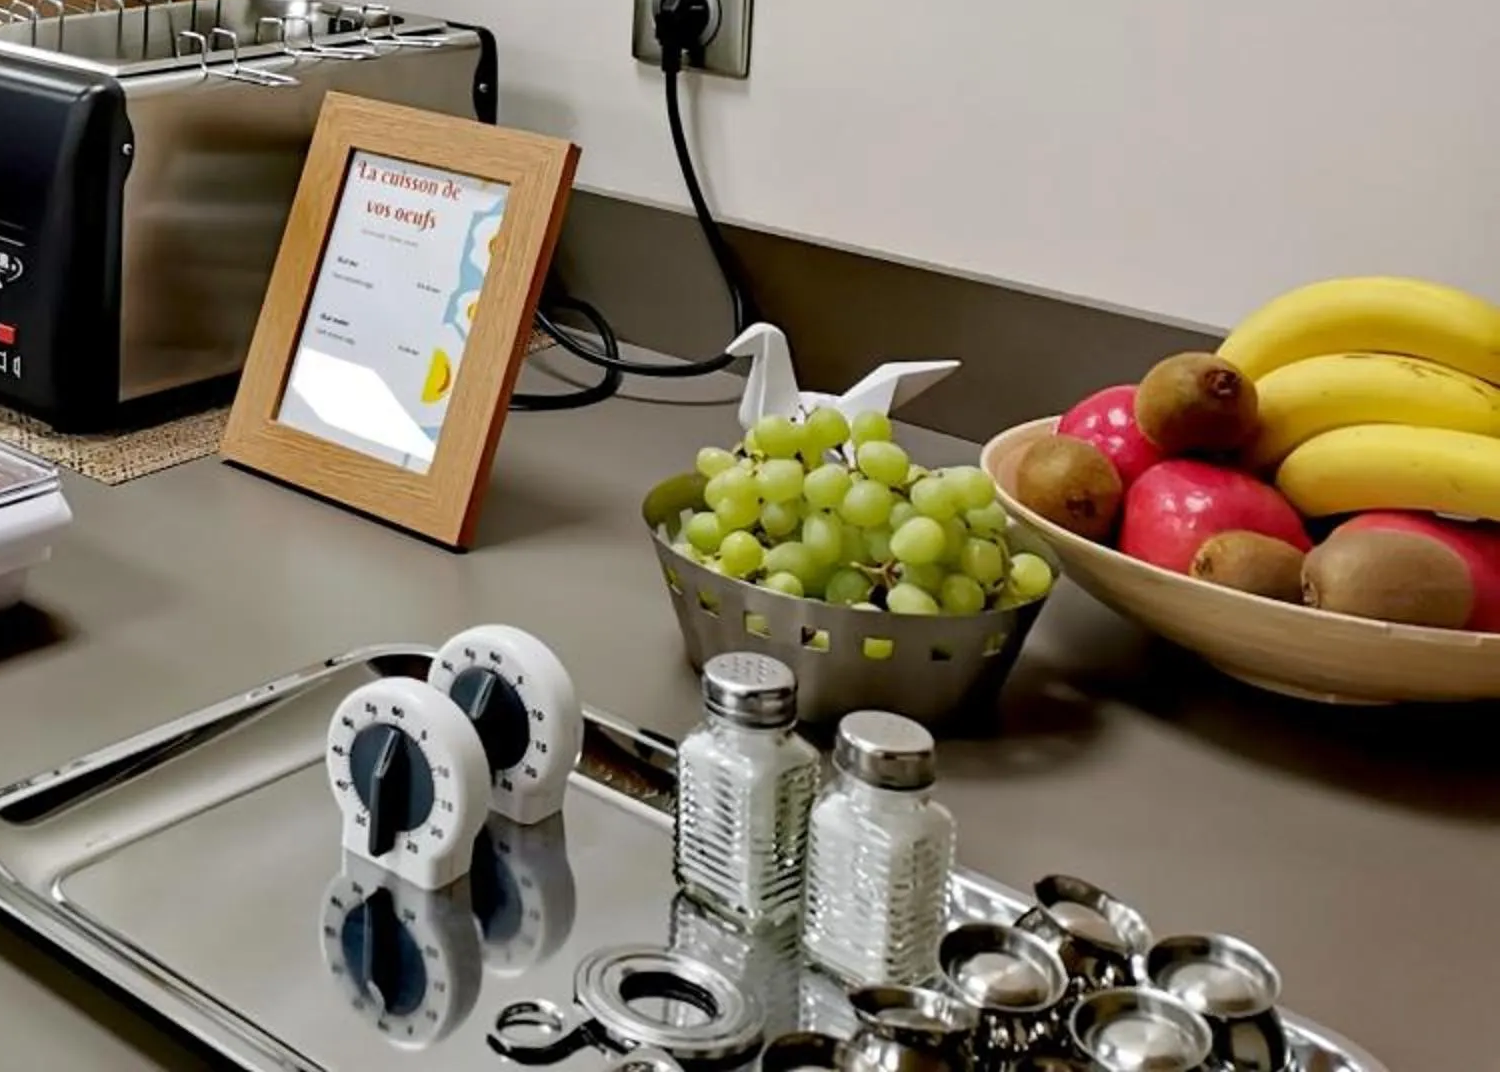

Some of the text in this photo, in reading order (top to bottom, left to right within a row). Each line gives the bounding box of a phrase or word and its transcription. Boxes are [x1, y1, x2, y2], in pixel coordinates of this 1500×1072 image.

[358, 160, 463, 201] La cuisson de
[366, 200, 391, 216] vos
